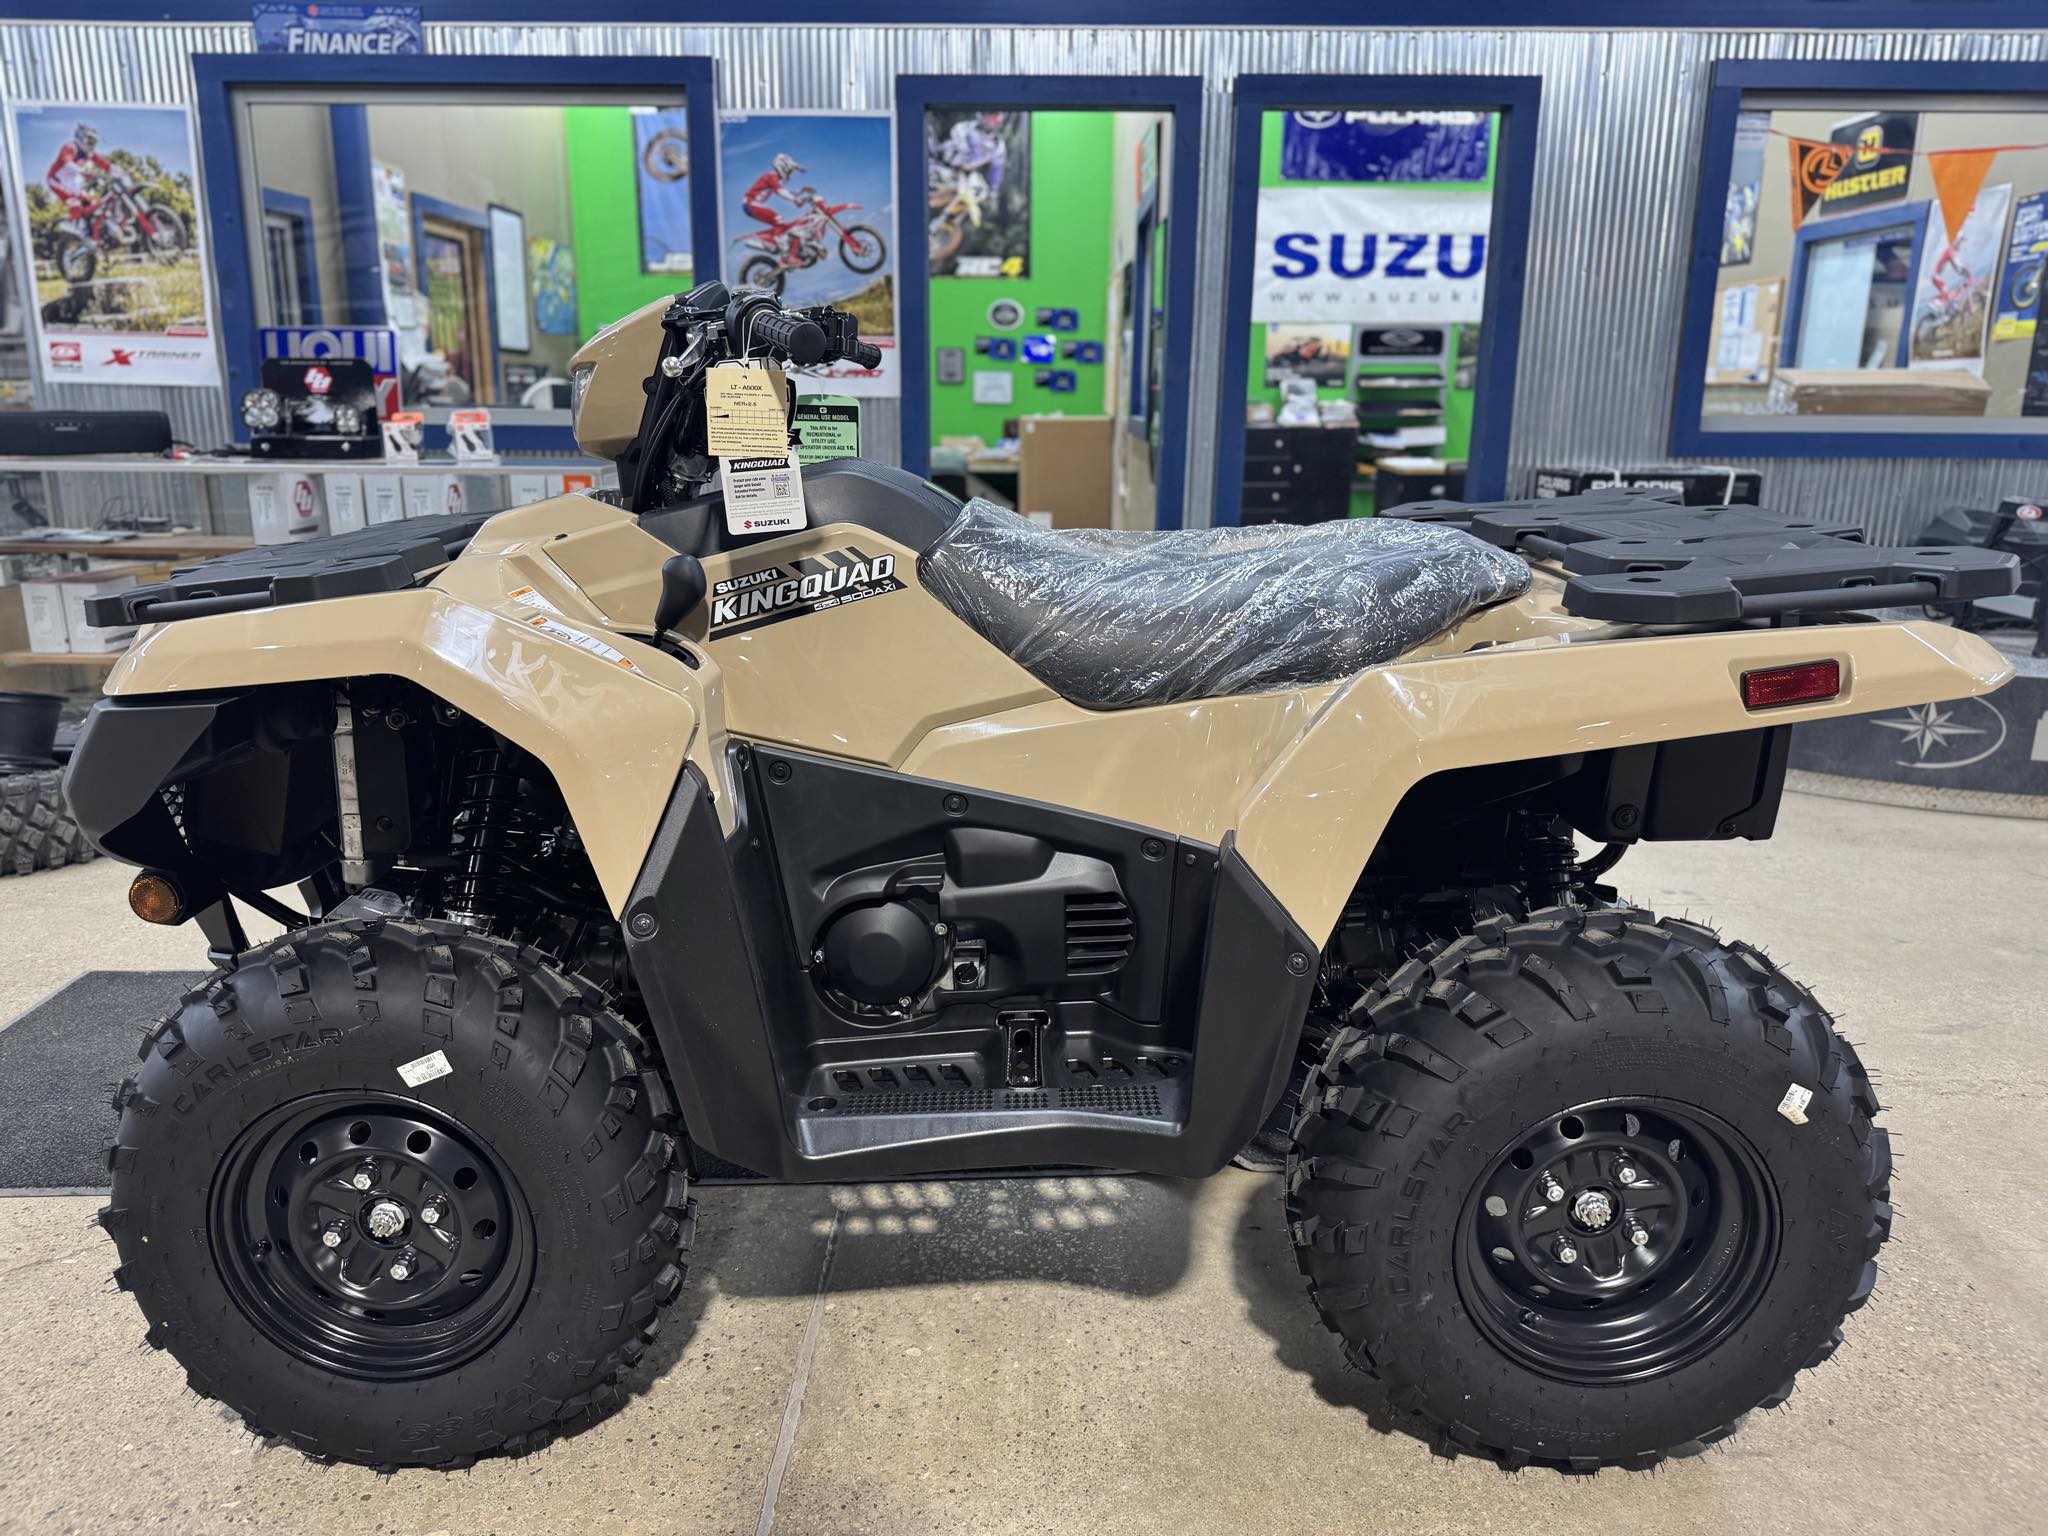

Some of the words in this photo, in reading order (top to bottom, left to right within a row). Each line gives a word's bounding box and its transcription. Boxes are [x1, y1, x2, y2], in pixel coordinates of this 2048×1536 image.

[287, 26, 392, 54] FINANCE
[1824, 165, 1906, 202] HUSTLER
[1271, 232, 1486, 280] SUZU
[819, 406, 828, 414] G
[733, 459, 786, 469] KINGQUAD
[753, 518, 790, 528] SUZUKI
[713, 553, 895, 625] KINGQUAD
[715, 568, 778, 595] SUZUKI
[174, 1027, 344, 1116] CARLSTAR
